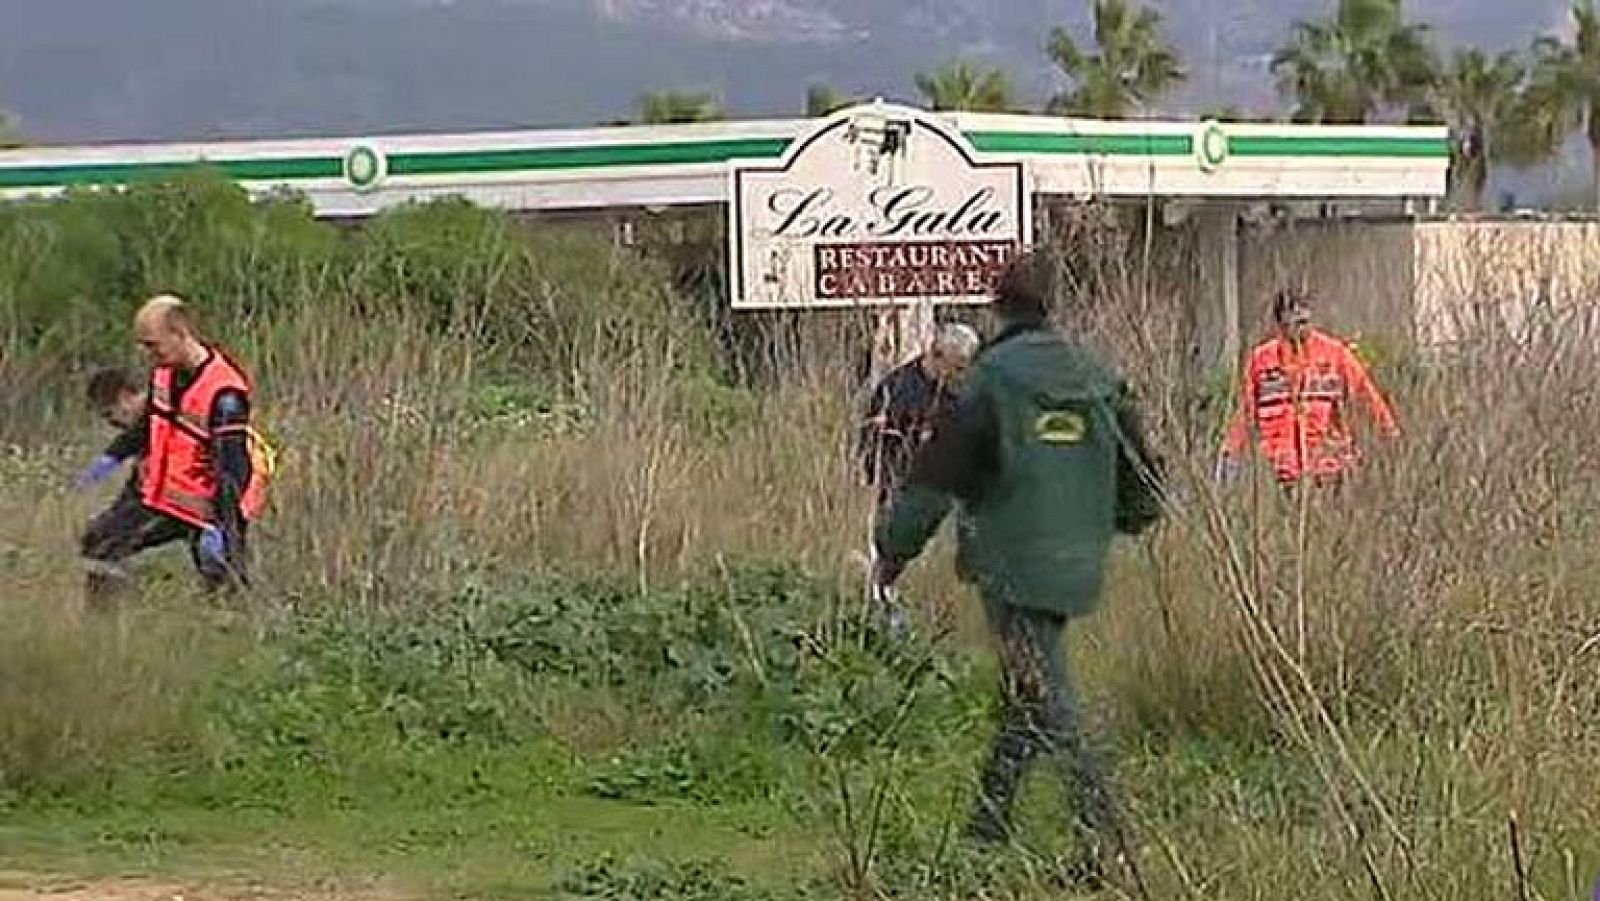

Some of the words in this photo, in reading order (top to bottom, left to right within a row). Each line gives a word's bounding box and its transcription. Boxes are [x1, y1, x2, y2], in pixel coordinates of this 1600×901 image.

[768, 187, 853, 237] La
[866, 186, 1002, 236] Gala
[820, 245, 1010, 269] RESTAURANT
